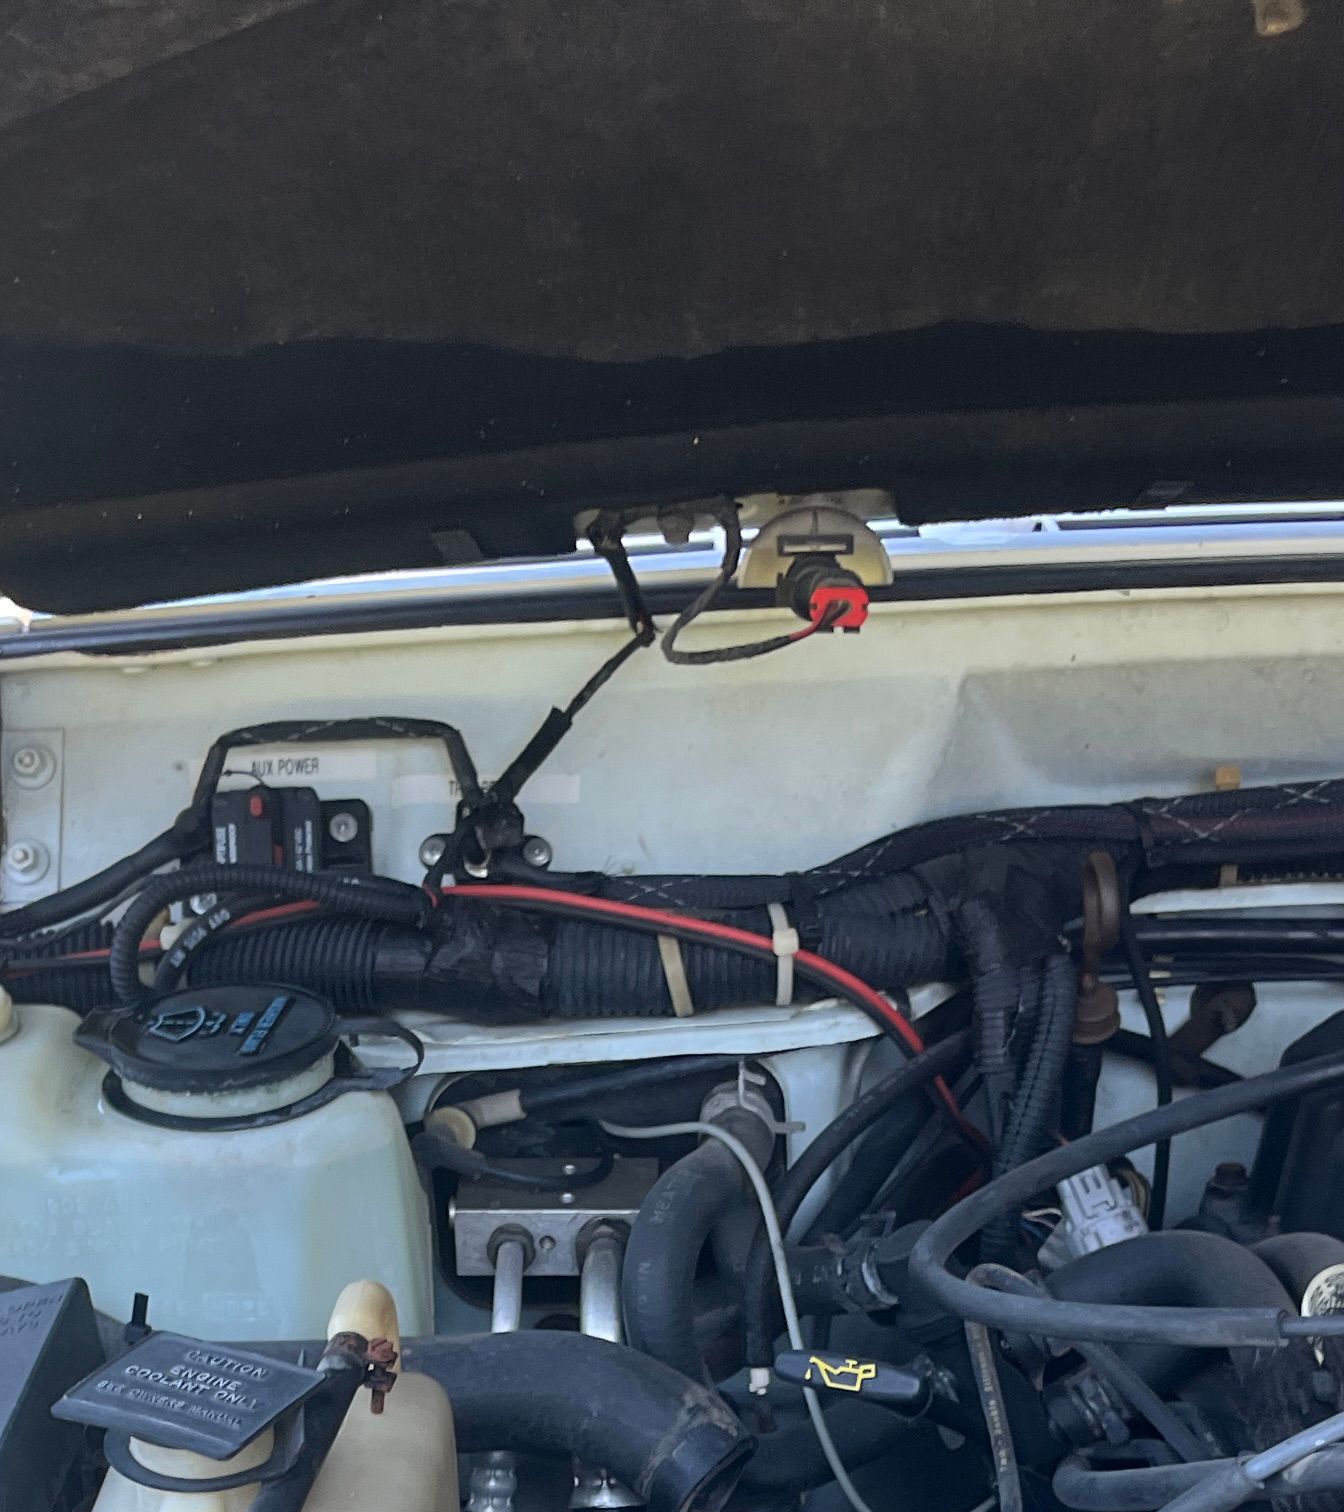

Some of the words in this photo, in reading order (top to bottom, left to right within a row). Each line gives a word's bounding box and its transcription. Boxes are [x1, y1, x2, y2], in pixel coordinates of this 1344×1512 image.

[251, 759, 274, 777] AUX
[278, 757, 319, 776] POWER
[184, 1350, 268, 1378] CAUTION
[124, 1364, 211, 1396] COOLANT
[169, 1365, 244, 1392] ENGINE
